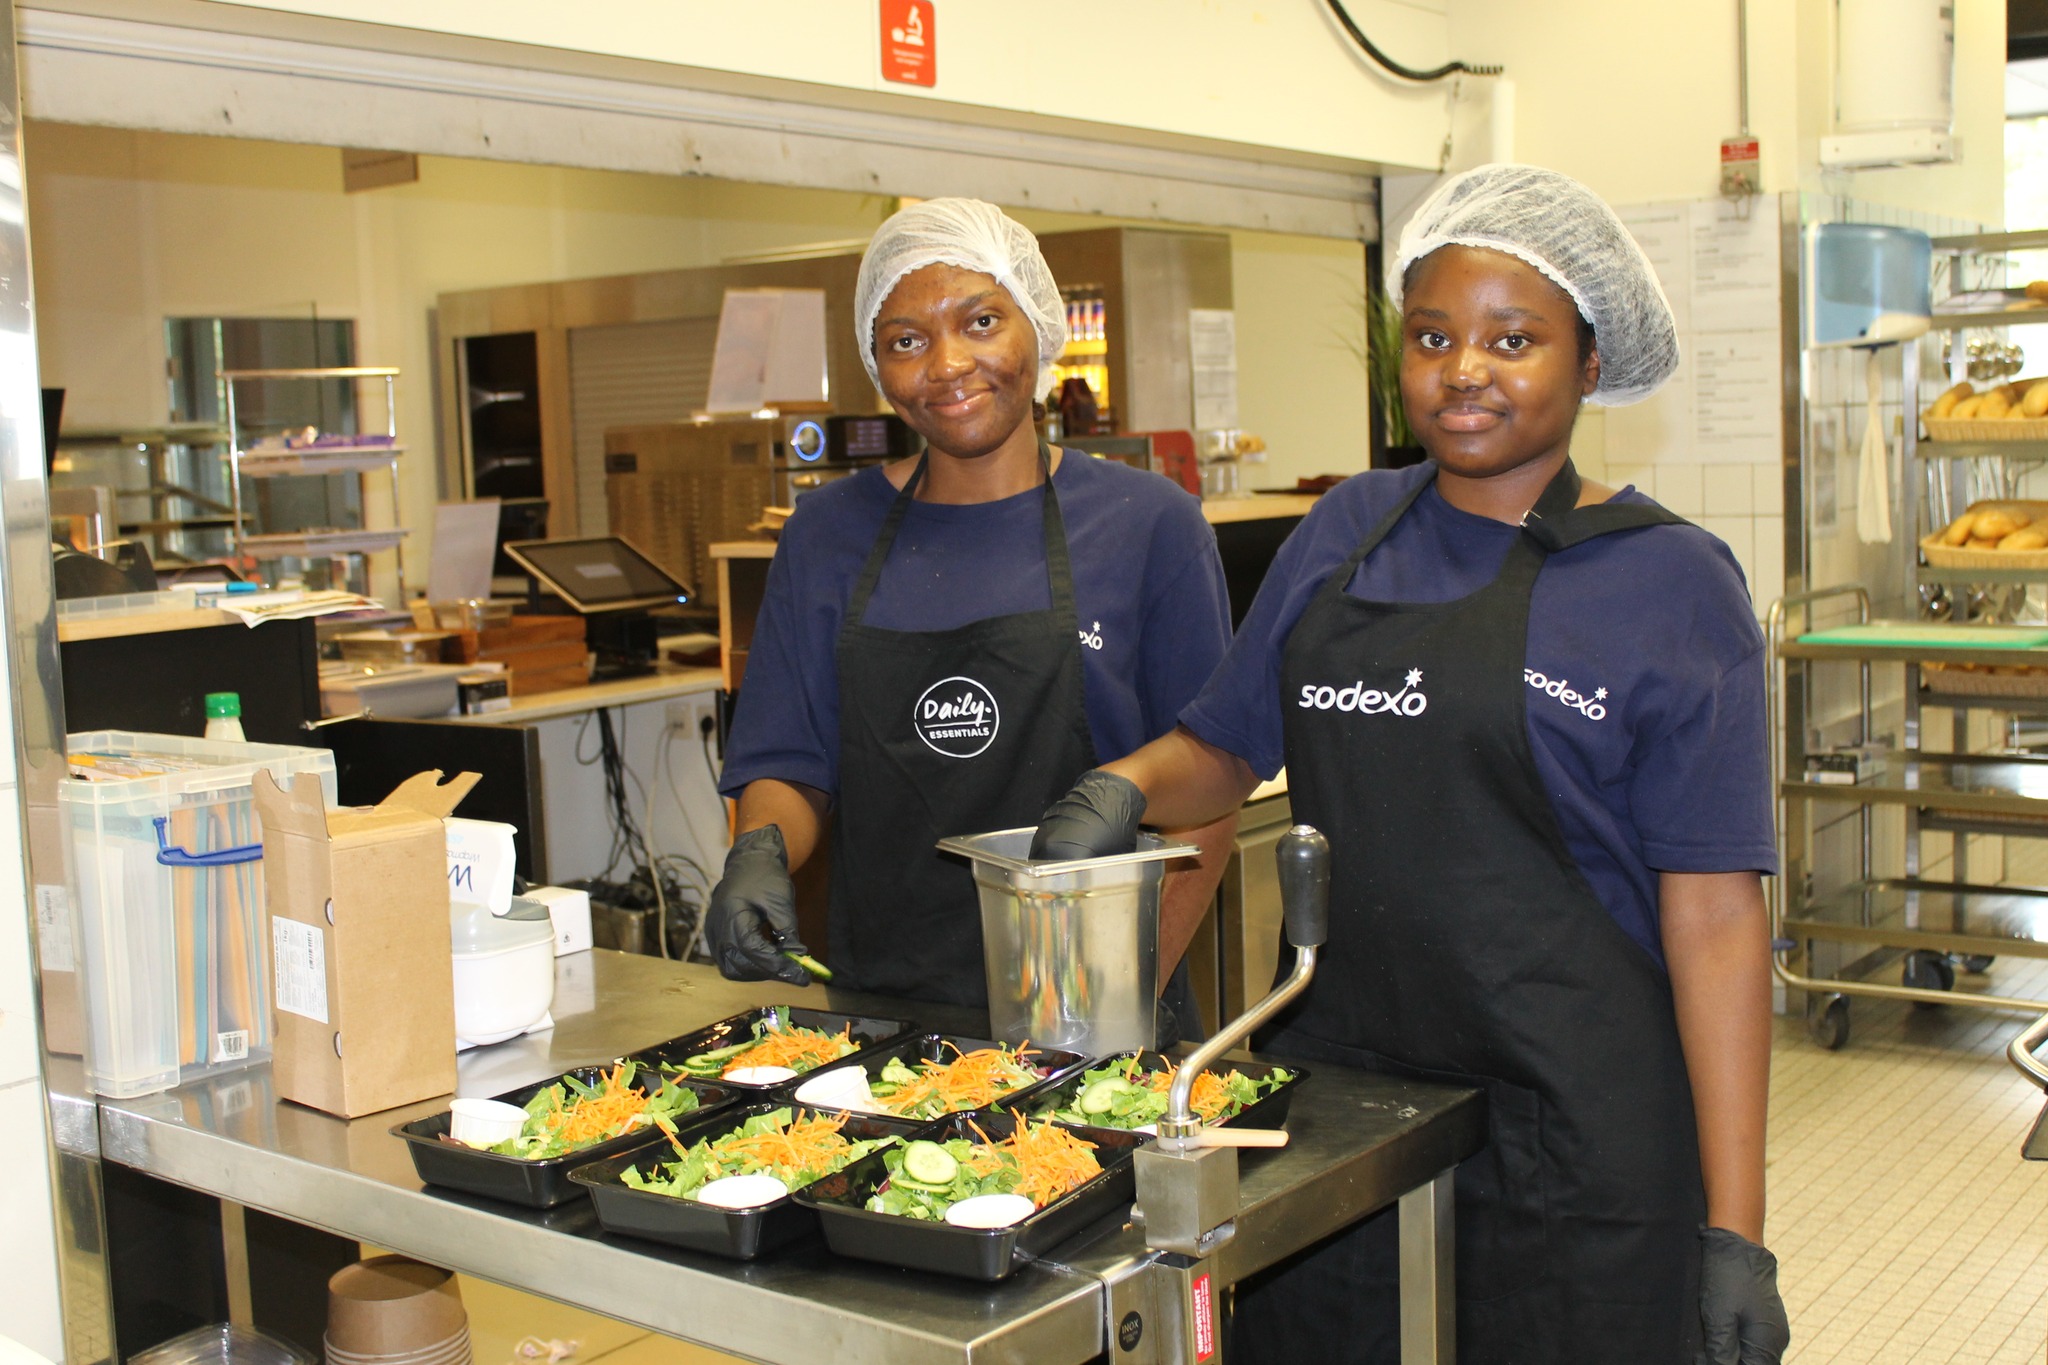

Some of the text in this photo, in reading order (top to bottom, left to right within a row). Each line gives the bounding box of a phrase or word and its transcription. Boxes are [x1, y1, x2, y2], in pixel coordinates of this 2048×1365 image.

[1299, 680, 1427, 717] sodexo
[929, 727, 990, 740] ESSENTIALS
[1121, 1319, 1139, 1335] INOX
[1194, 1289, 1204, 1354] IMPORTANT
